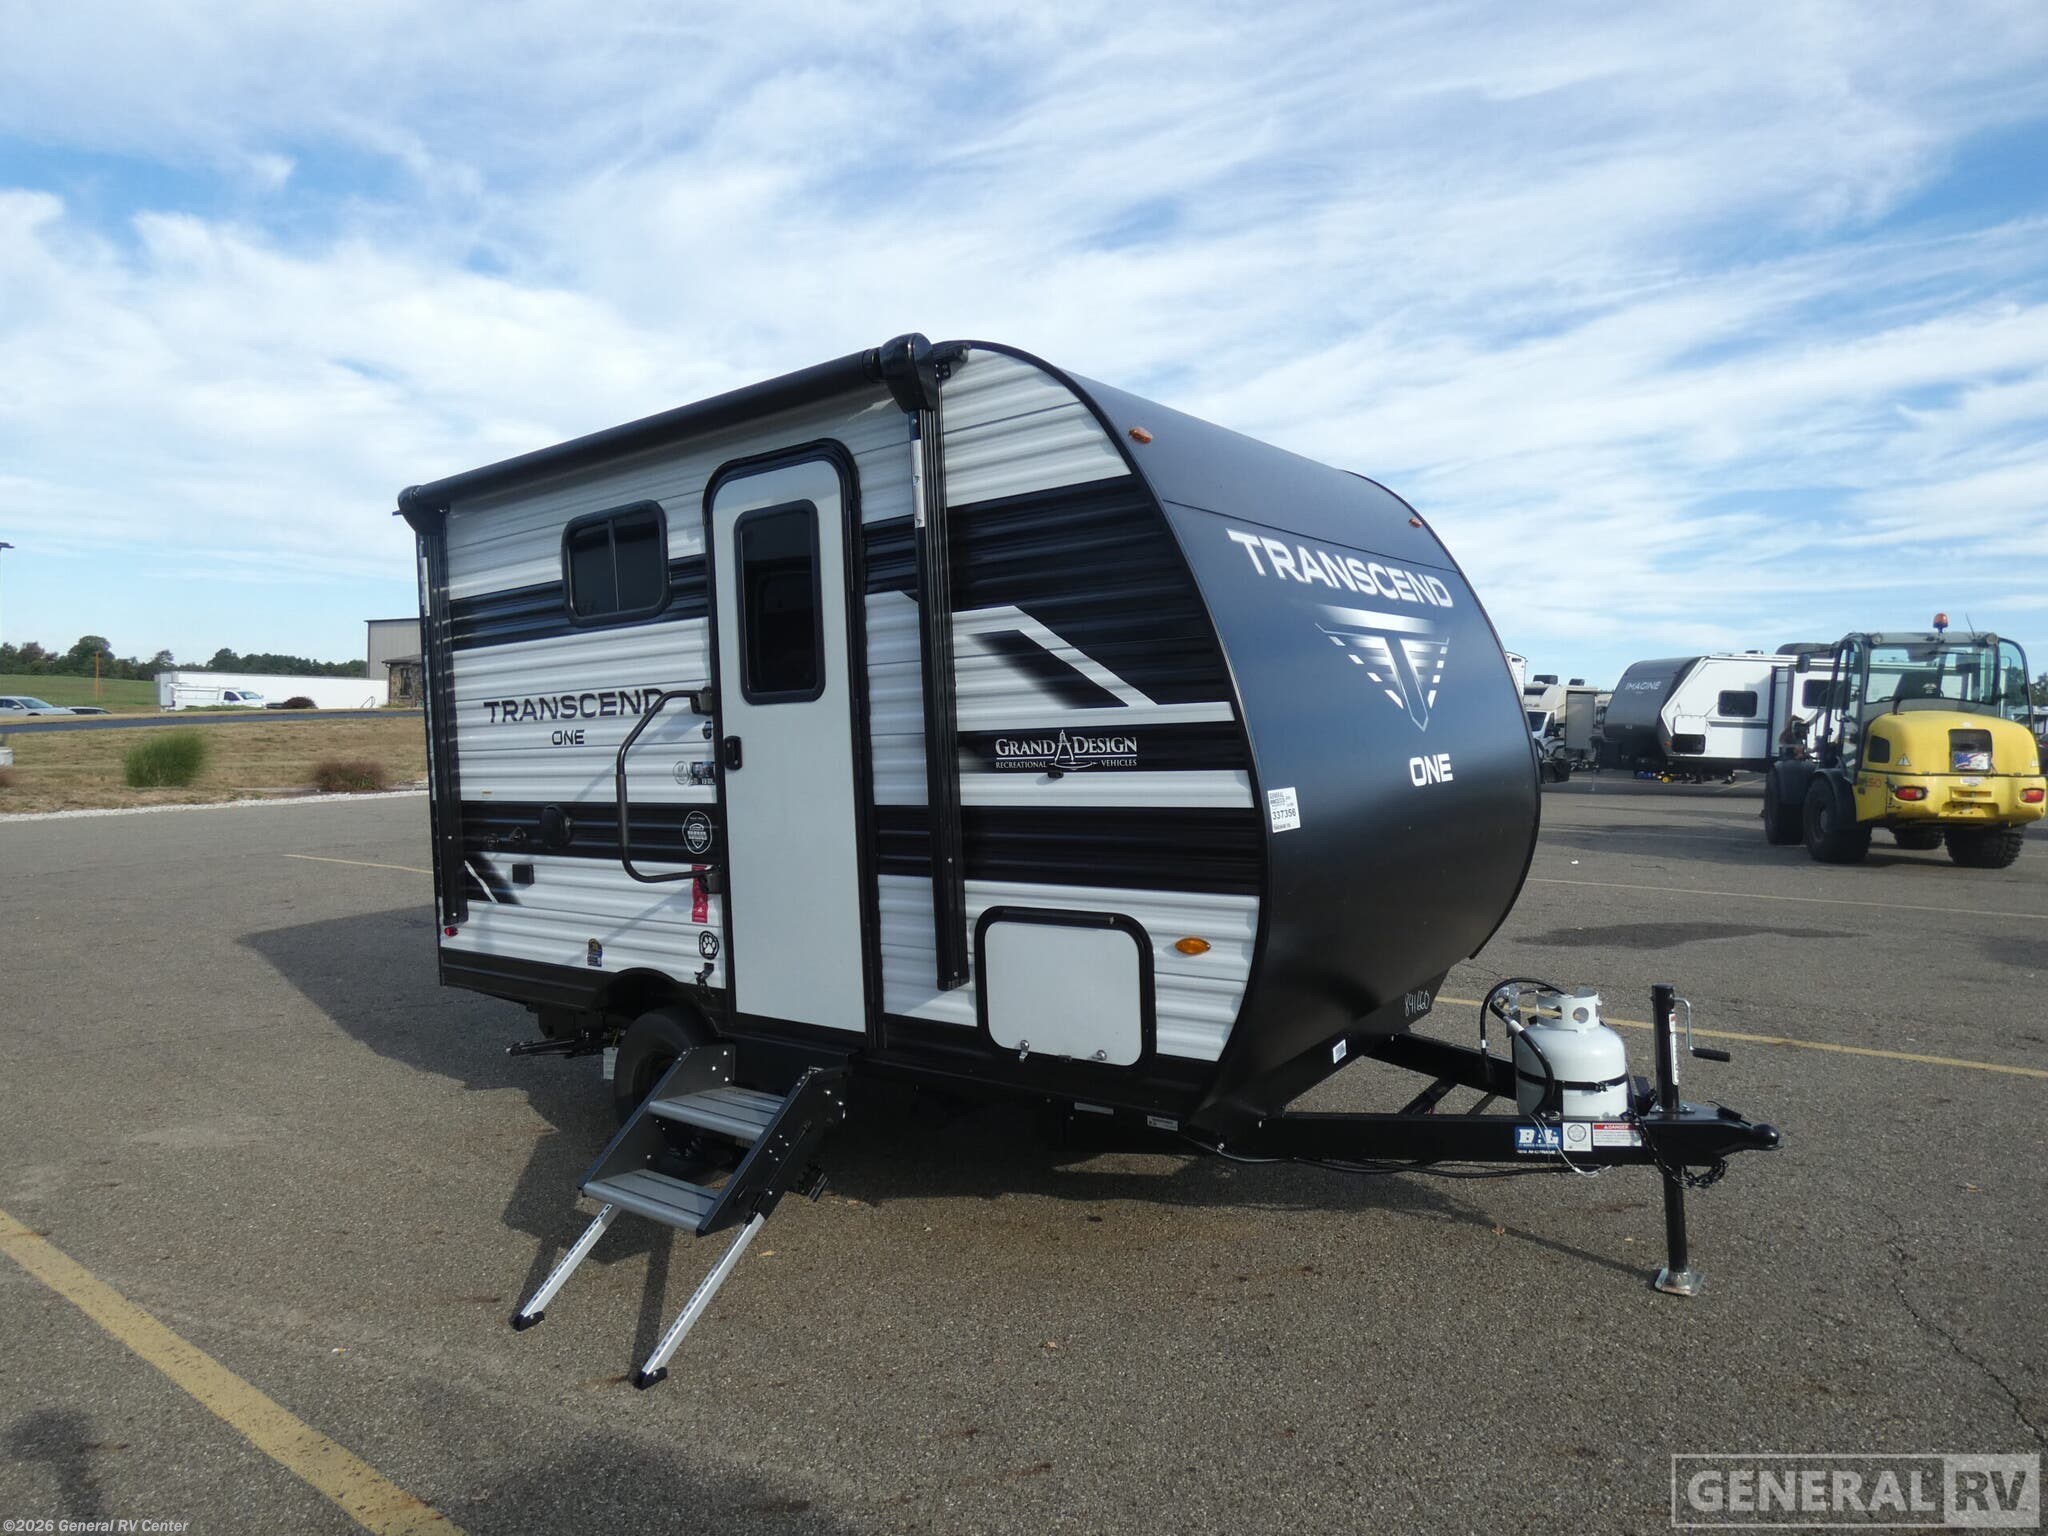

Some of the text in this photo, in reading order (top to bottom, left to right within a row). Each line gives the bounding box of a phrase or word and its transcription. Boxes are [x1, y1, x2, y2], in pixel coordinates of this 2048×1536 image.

[1225, 527, 1454, 609] TRANSCEND
[1624, 680, 1662, 690] IMAGINE
[483, 687, 665, 724] TRANSCEND
[551, 728, 585, 746] ONE
[994, 734, 1138, 757] GRAND DESIGN
[994, 757, 1138, 769] RECREATIONAL VEHICLES
[1408, 752, 1454, 788] ONE
